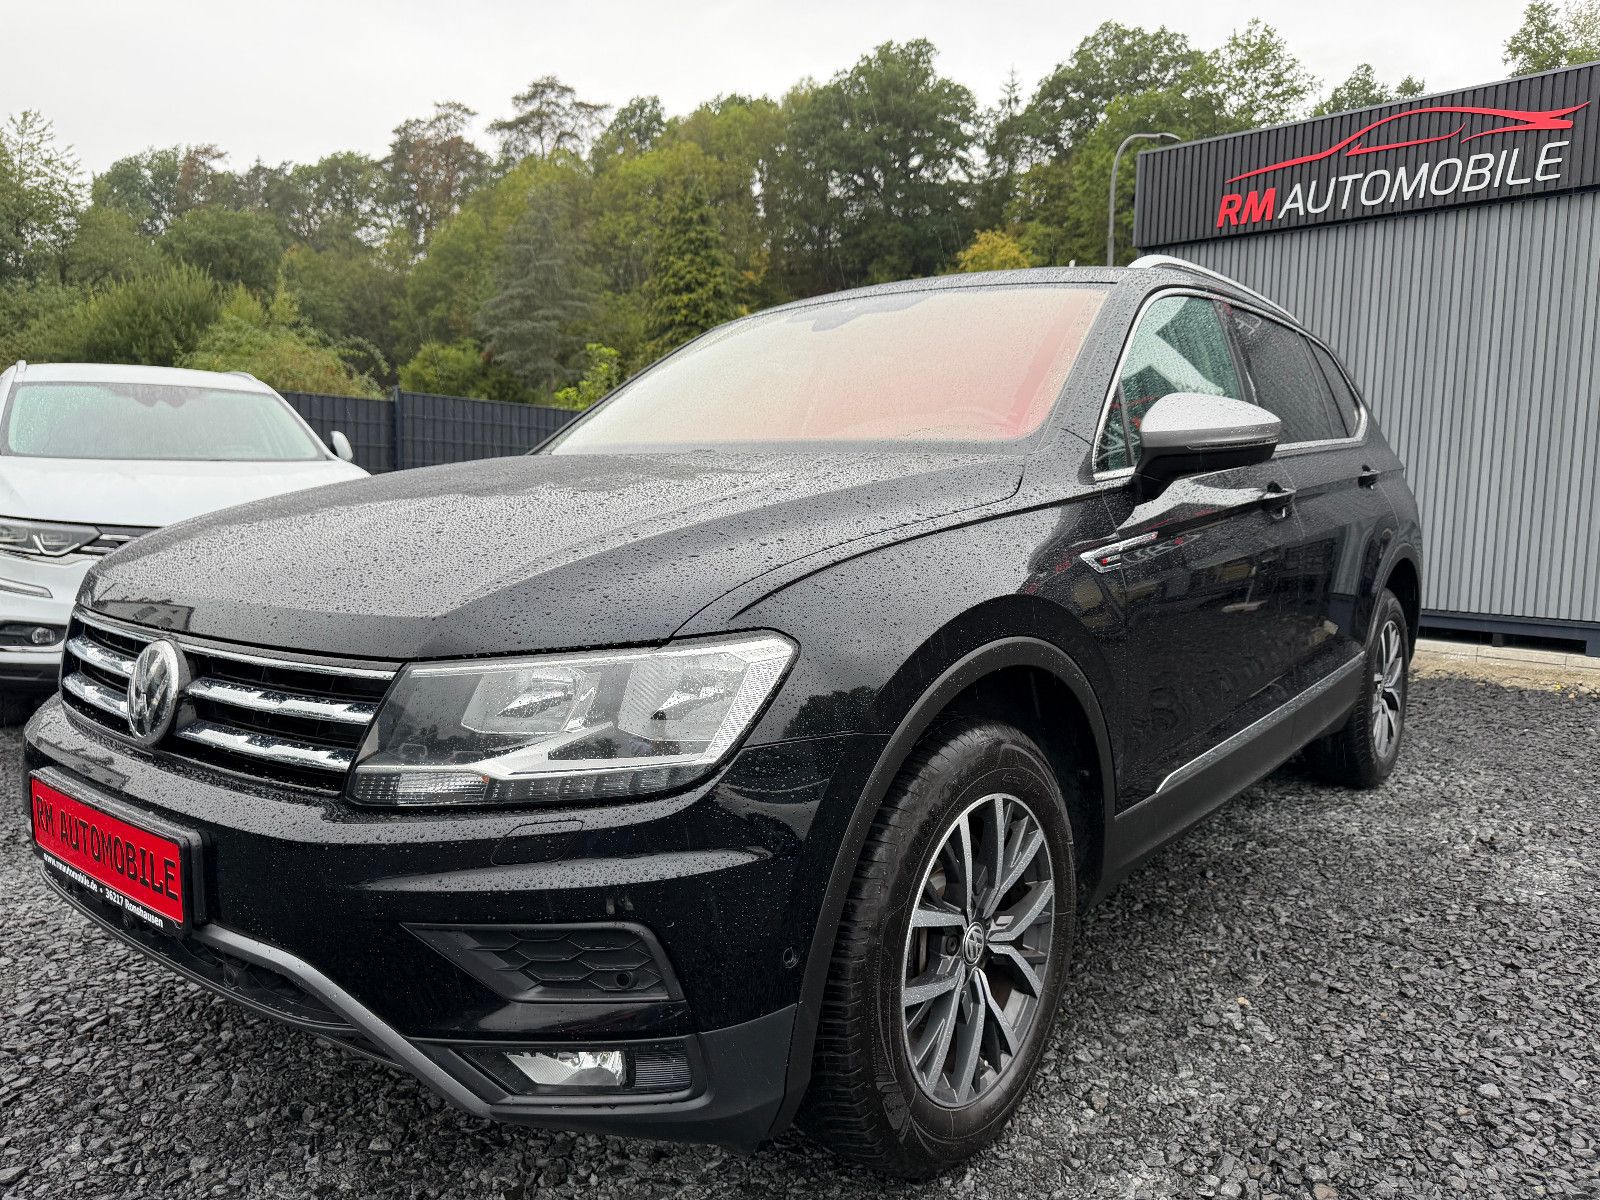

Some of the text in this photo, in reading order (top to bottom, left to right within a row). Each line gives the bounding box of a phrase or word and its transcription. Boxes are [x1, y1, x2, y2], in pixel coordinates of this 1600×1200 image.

[1216, 140, 1570, 229] RM AUTOMOBILE
[36, 795, 179, 902] RM AUTOMOBILE
[105, 888, 124, 907] 36217
[125, 899, 164, 929] Ronshausen
